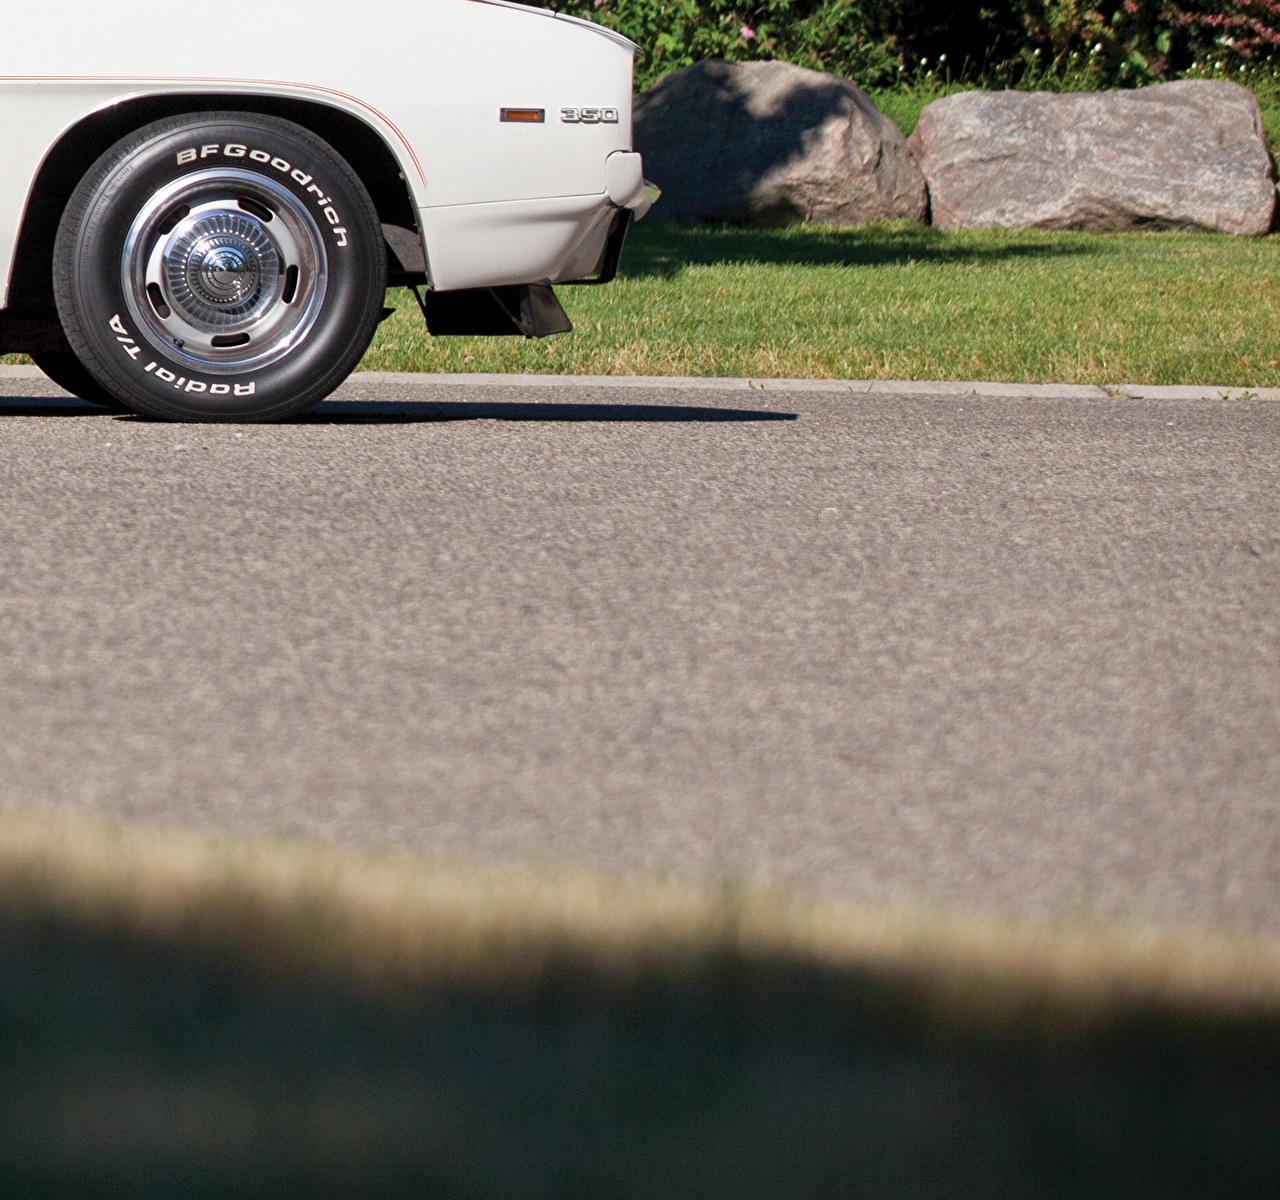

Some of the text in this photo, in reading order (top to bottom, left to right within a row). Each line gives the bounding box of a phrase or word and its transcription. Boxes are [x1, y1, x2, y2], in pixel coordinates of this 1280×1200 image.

[560, 107, 619, 124] 350
[176, 143, 349, 248] BFGoodrich
[109, 313, 257, 397] Radial T/A
